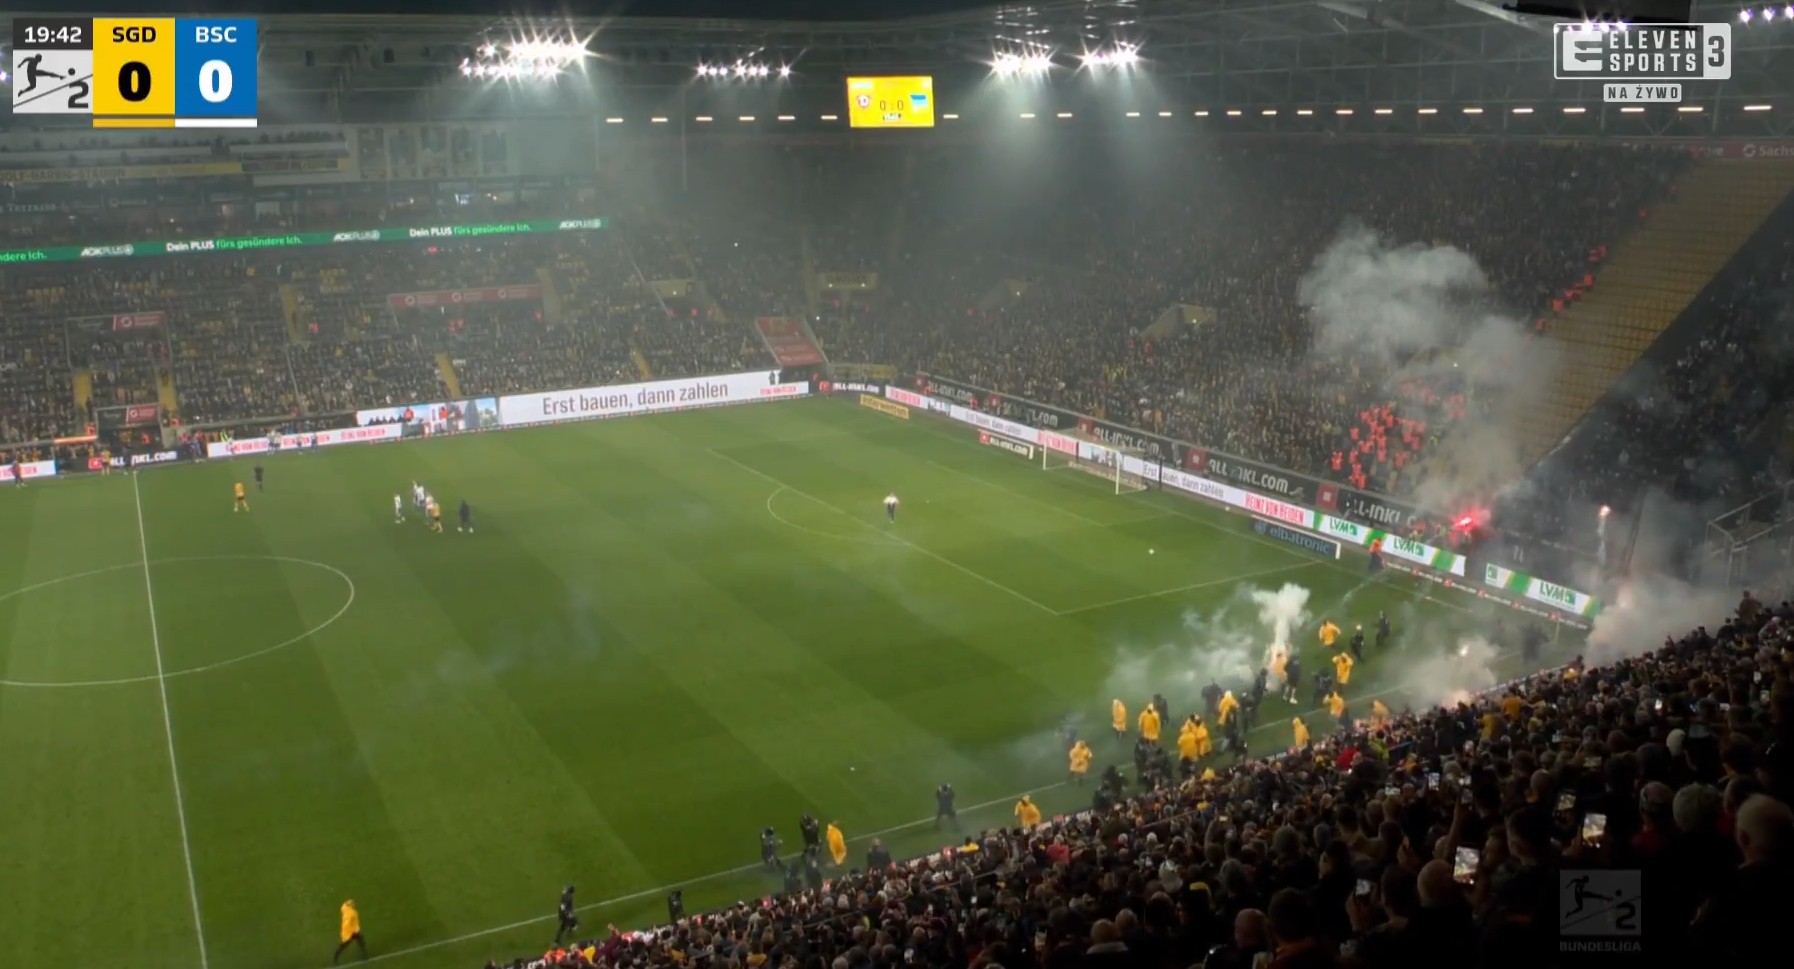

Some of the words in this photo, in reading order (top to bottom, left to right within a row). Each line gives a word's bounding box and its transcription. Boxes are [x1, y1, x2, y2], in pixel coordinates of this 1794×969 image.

[409, 228, 430, 238] Dein
[431, 226, 452, 236] PLUS
[166, 242, 189, 252] Dein
[190, 240, 214, 250] PLUS
[543, 397, 575, 415] Erst
[580, 391, 633, 412] bauen,
[637, 386, 676, 406] dann
[679, 381, 728, 402] zahlen
[1539, 581, 1565, 603] LVM
